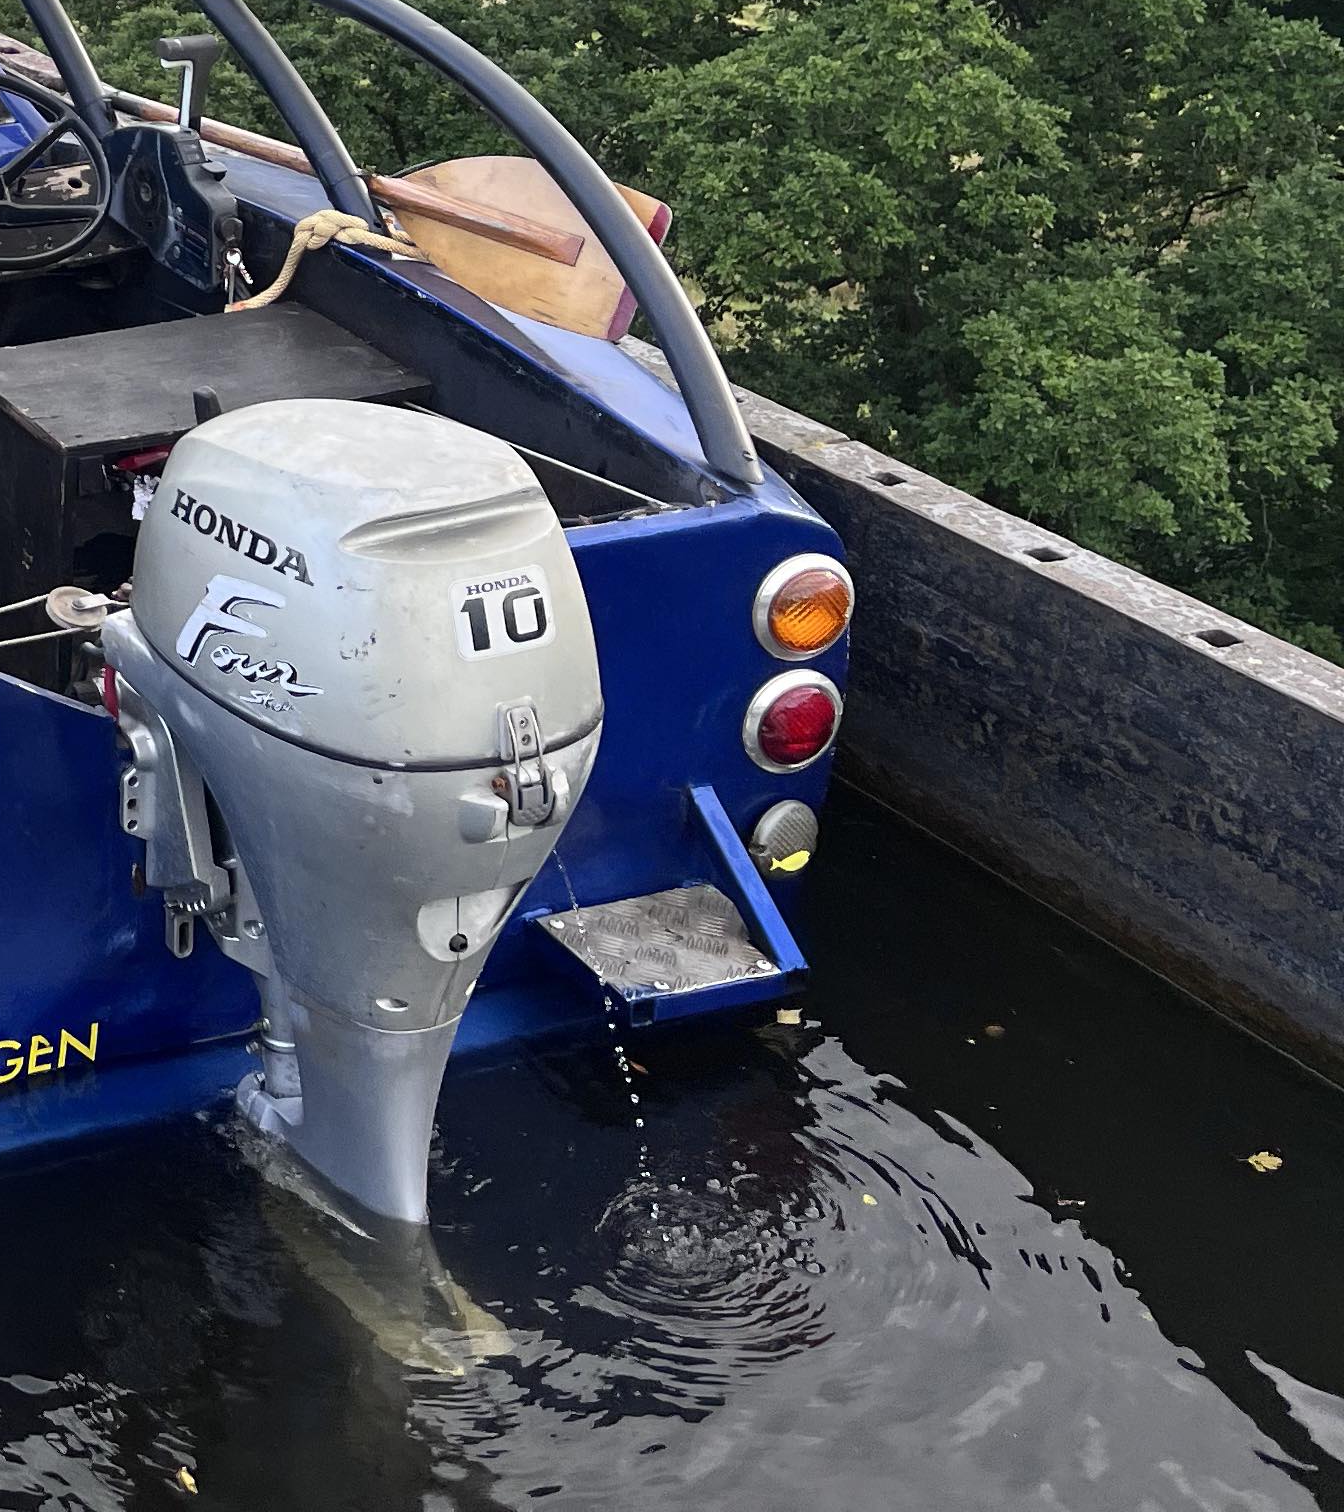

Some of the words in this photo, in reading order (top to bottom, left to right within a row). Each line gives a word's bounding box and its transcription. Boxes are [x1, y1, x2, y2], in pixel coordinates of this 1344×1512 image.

[170, 488, 315, 587] HONDA
[460, 586, 548, 652] 10
[465, 574, 533, 596] HONDA
[175, 574, 325, 698] Four
